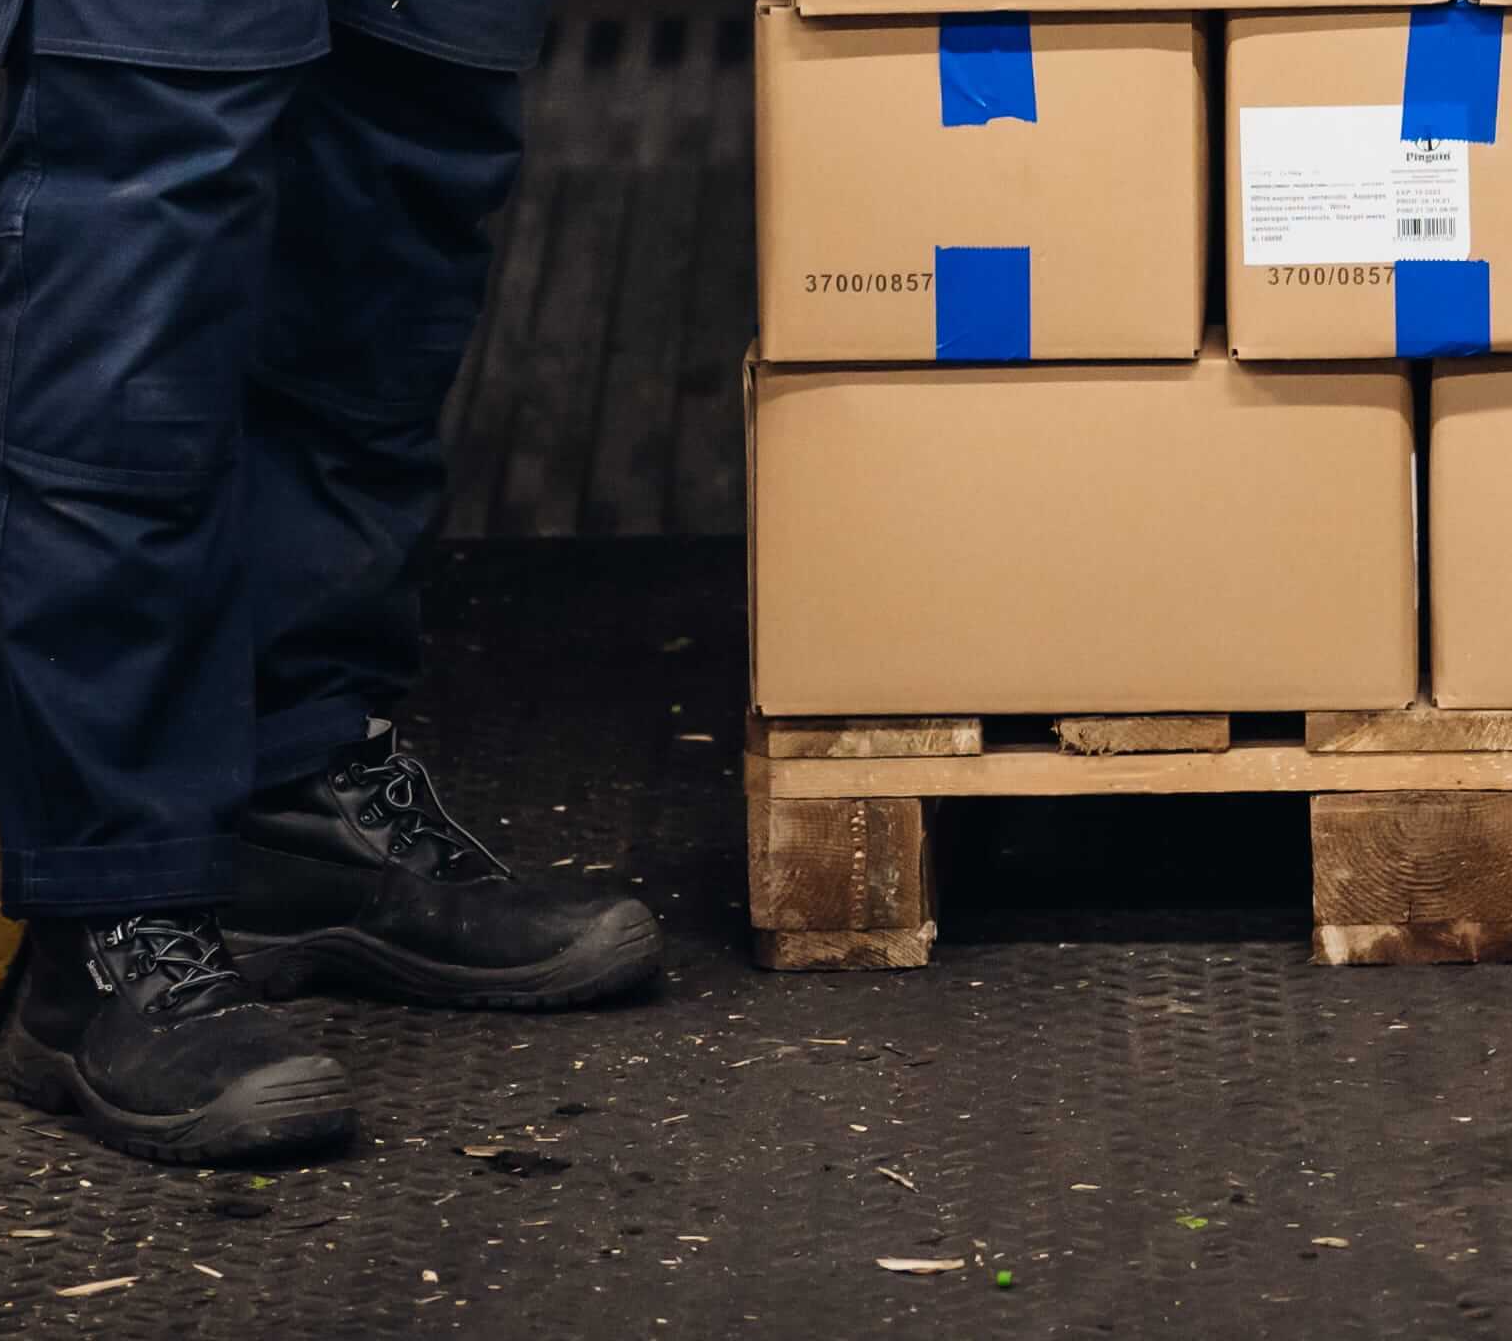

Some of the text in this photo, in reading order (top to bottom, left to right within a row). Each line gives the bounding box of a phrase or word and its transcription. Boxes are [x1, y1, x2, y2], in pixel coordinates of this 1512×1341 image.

[1405, 151, 1450, 164] Pinguin
[804, 272, 933, 294] 3700/0857
[1267, 264, 1395, 286] 3700/0857
